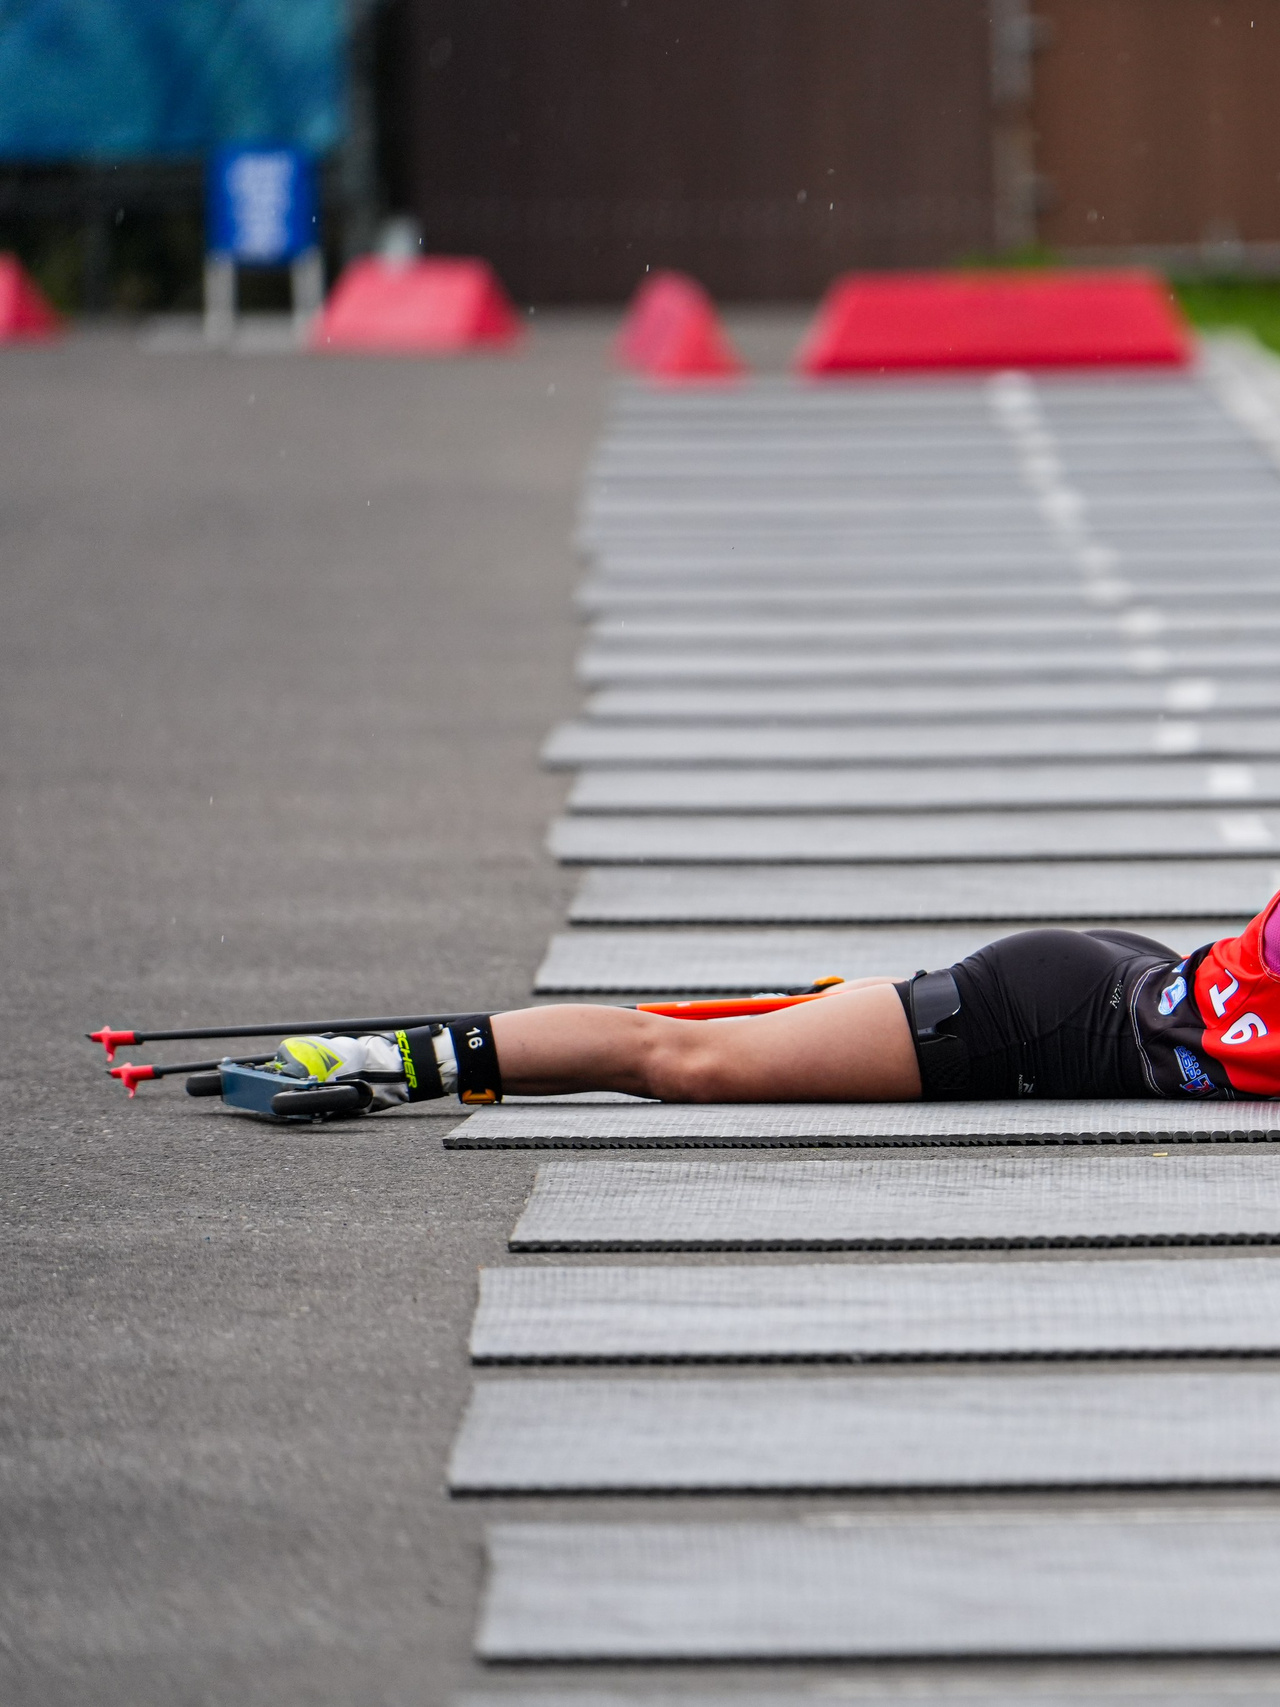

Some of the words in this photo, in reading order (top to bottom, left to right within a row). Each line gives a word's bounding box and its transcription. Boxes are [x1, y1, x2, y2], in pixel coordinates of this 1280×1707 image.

[1208, 968, 1268, 1045] 16
[395, 1030, 418, 1088] SCHER
[466, 1027, 483, 1050] 16
